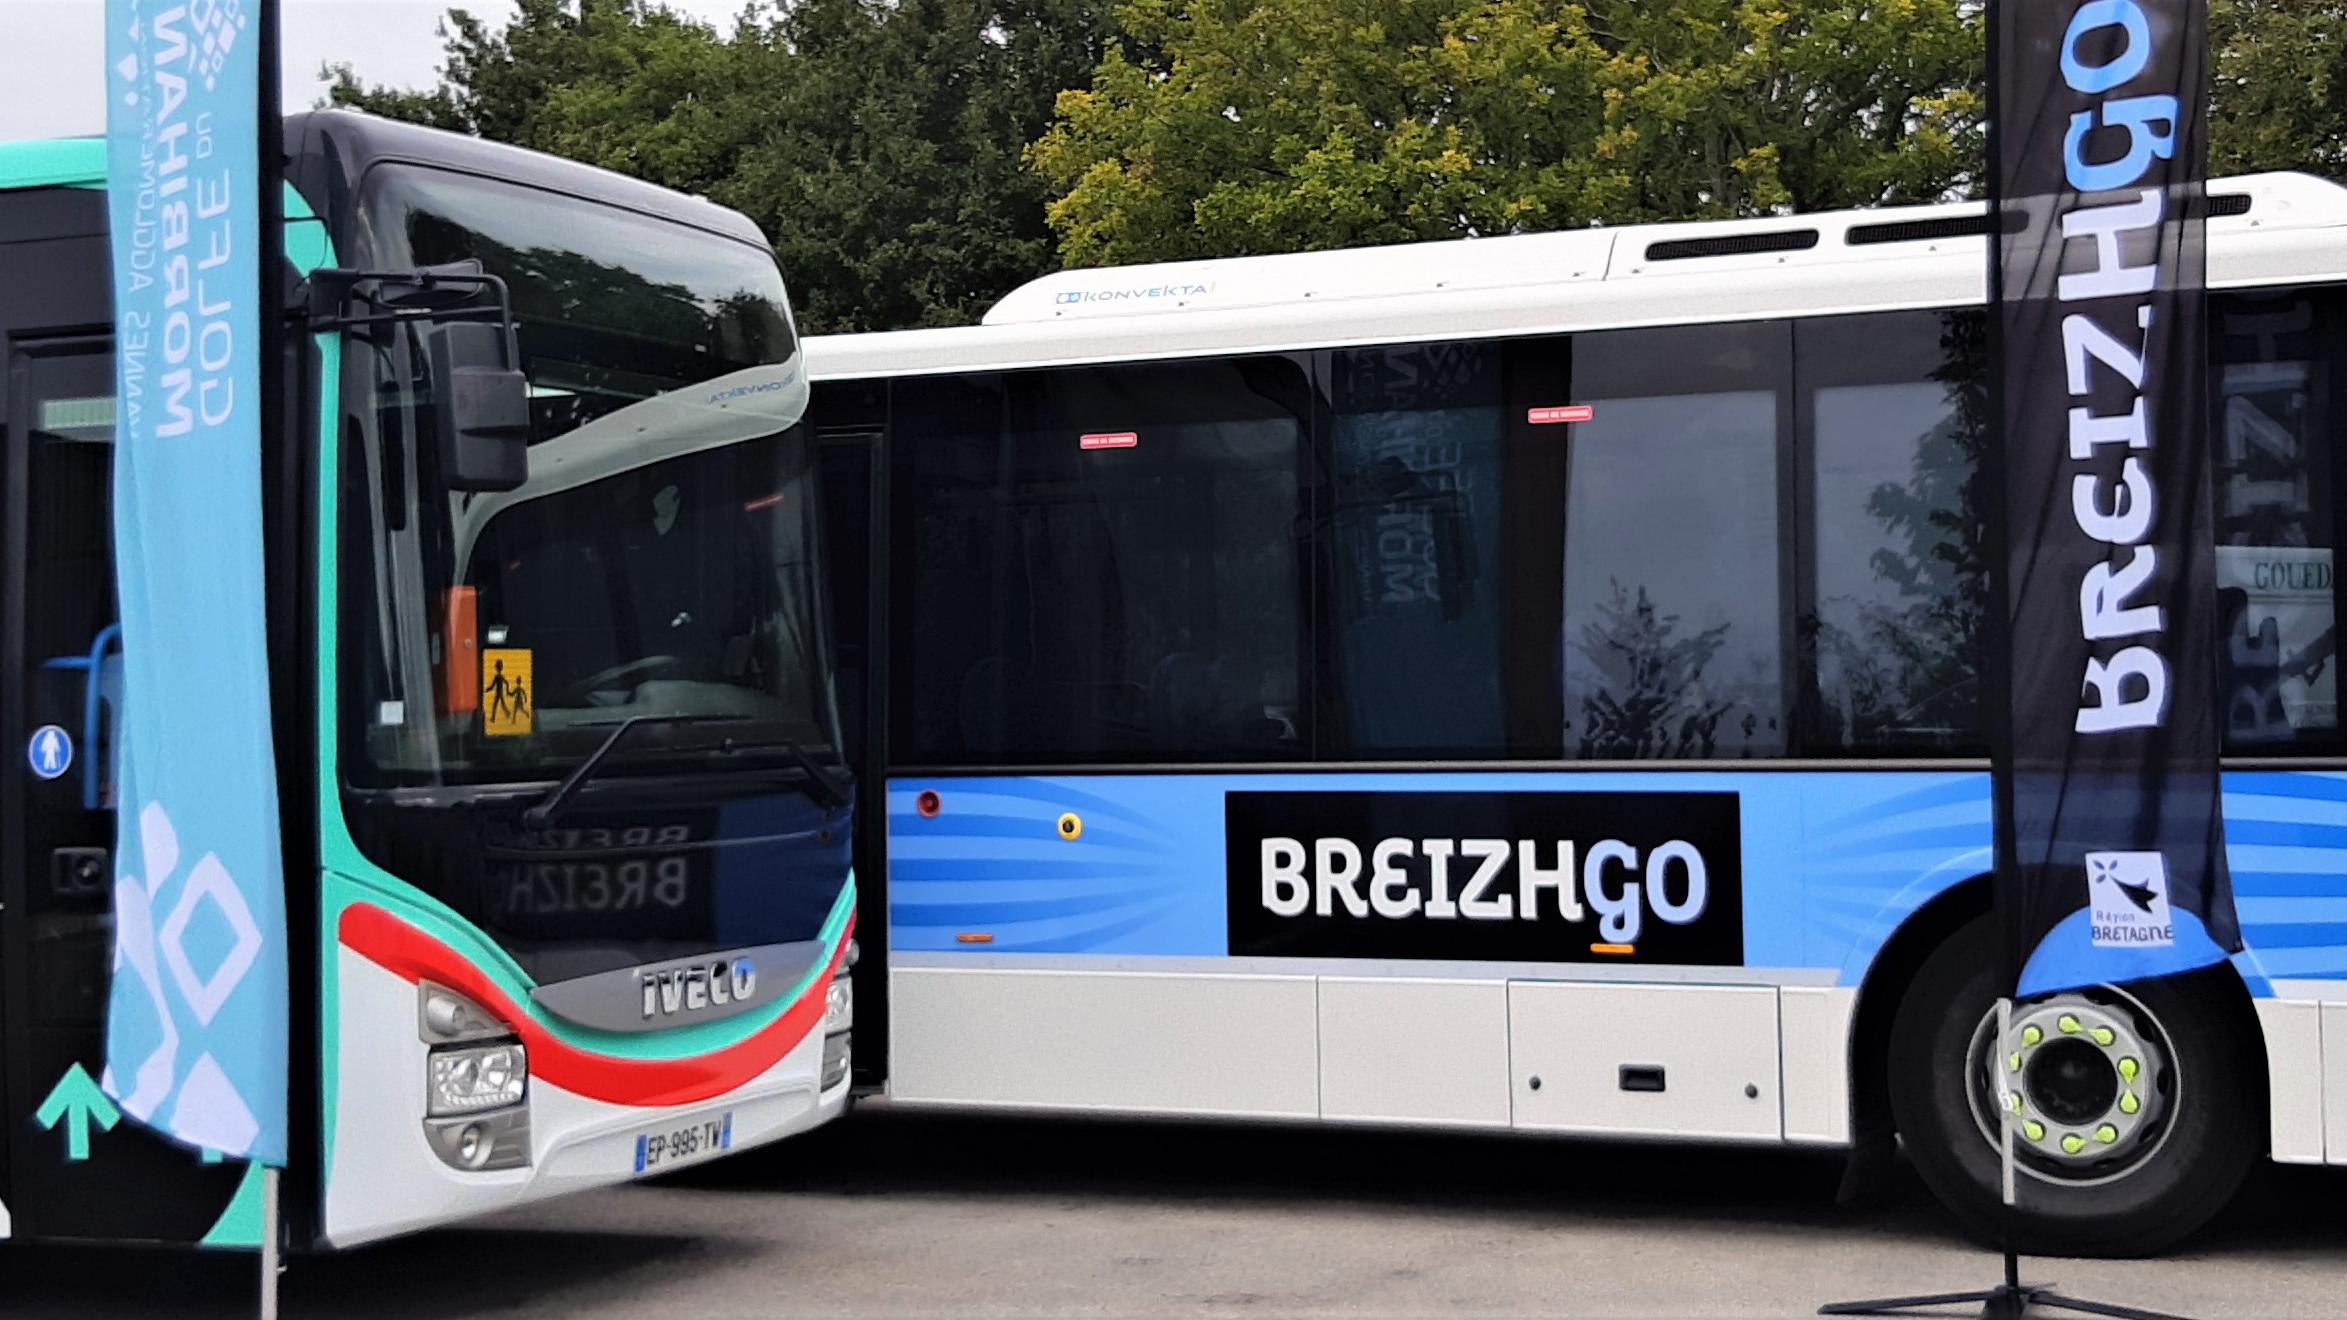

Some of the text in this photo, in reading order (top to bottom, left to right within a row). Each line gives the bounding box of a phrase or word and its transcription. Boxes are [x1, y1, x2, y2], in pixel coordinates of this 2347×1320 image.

[1084, 284, 1207, 302] KONVEKTA
[1260, 836, 1709, 943] BREIZHGO
[2091, 925, 2175, 942] BRETAGNE
[642, 956, 756, 1020] IVECO
